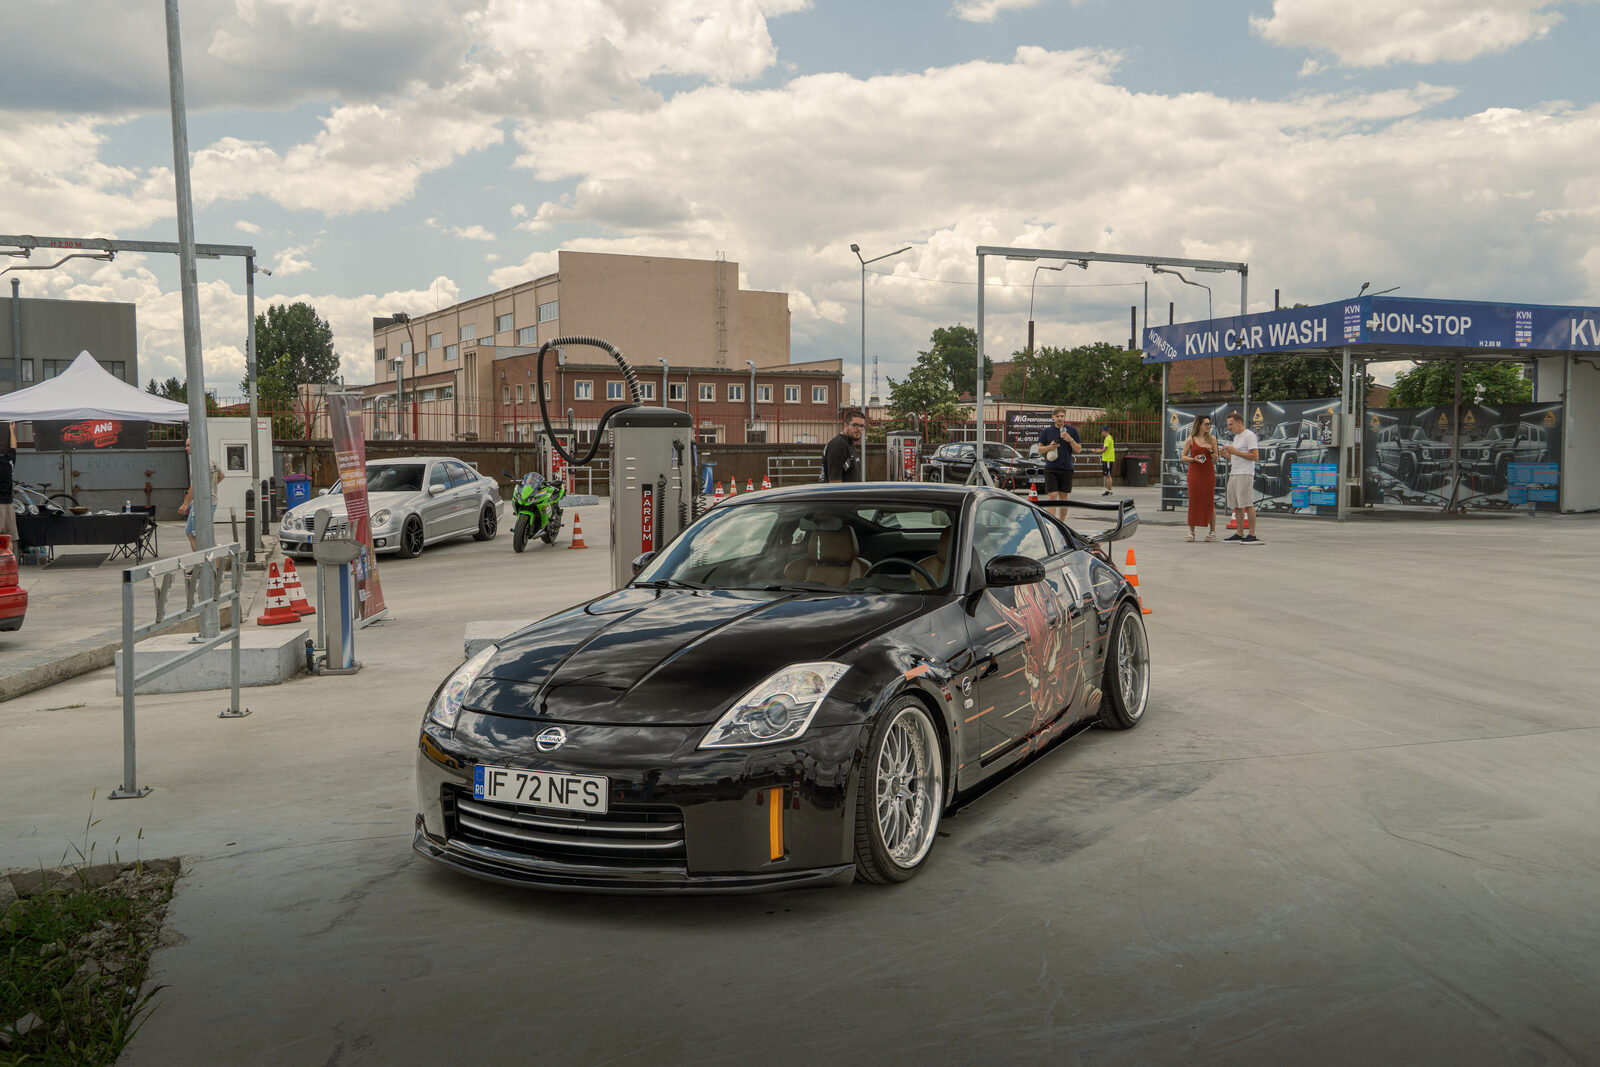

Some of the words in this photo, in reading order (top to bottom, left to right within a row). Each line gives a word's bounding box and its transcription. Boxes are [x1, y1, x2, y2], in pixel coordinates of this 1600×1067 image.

[1345, 305, 1360, 314] KVN
[1517, 311, 1532, 319] KVN
[1185, 331, 1219, 355] KVN
[1224, 325, 1263, 351] CAR
[1268, 318, 1327, 347] WASH
[1373, 312, 1472, 335] NON-STOP
[1148, 329, 1177, 359] NON-STOP
[94, 421, 113, 435] ANG
[643, 491, 651, 540] PARFUM
[475, 784, 484, 795] RO
[488, 771, 508, 796] IF
[516, 774, 542, 802] 72
[549, 777, 599, 807] NFS
